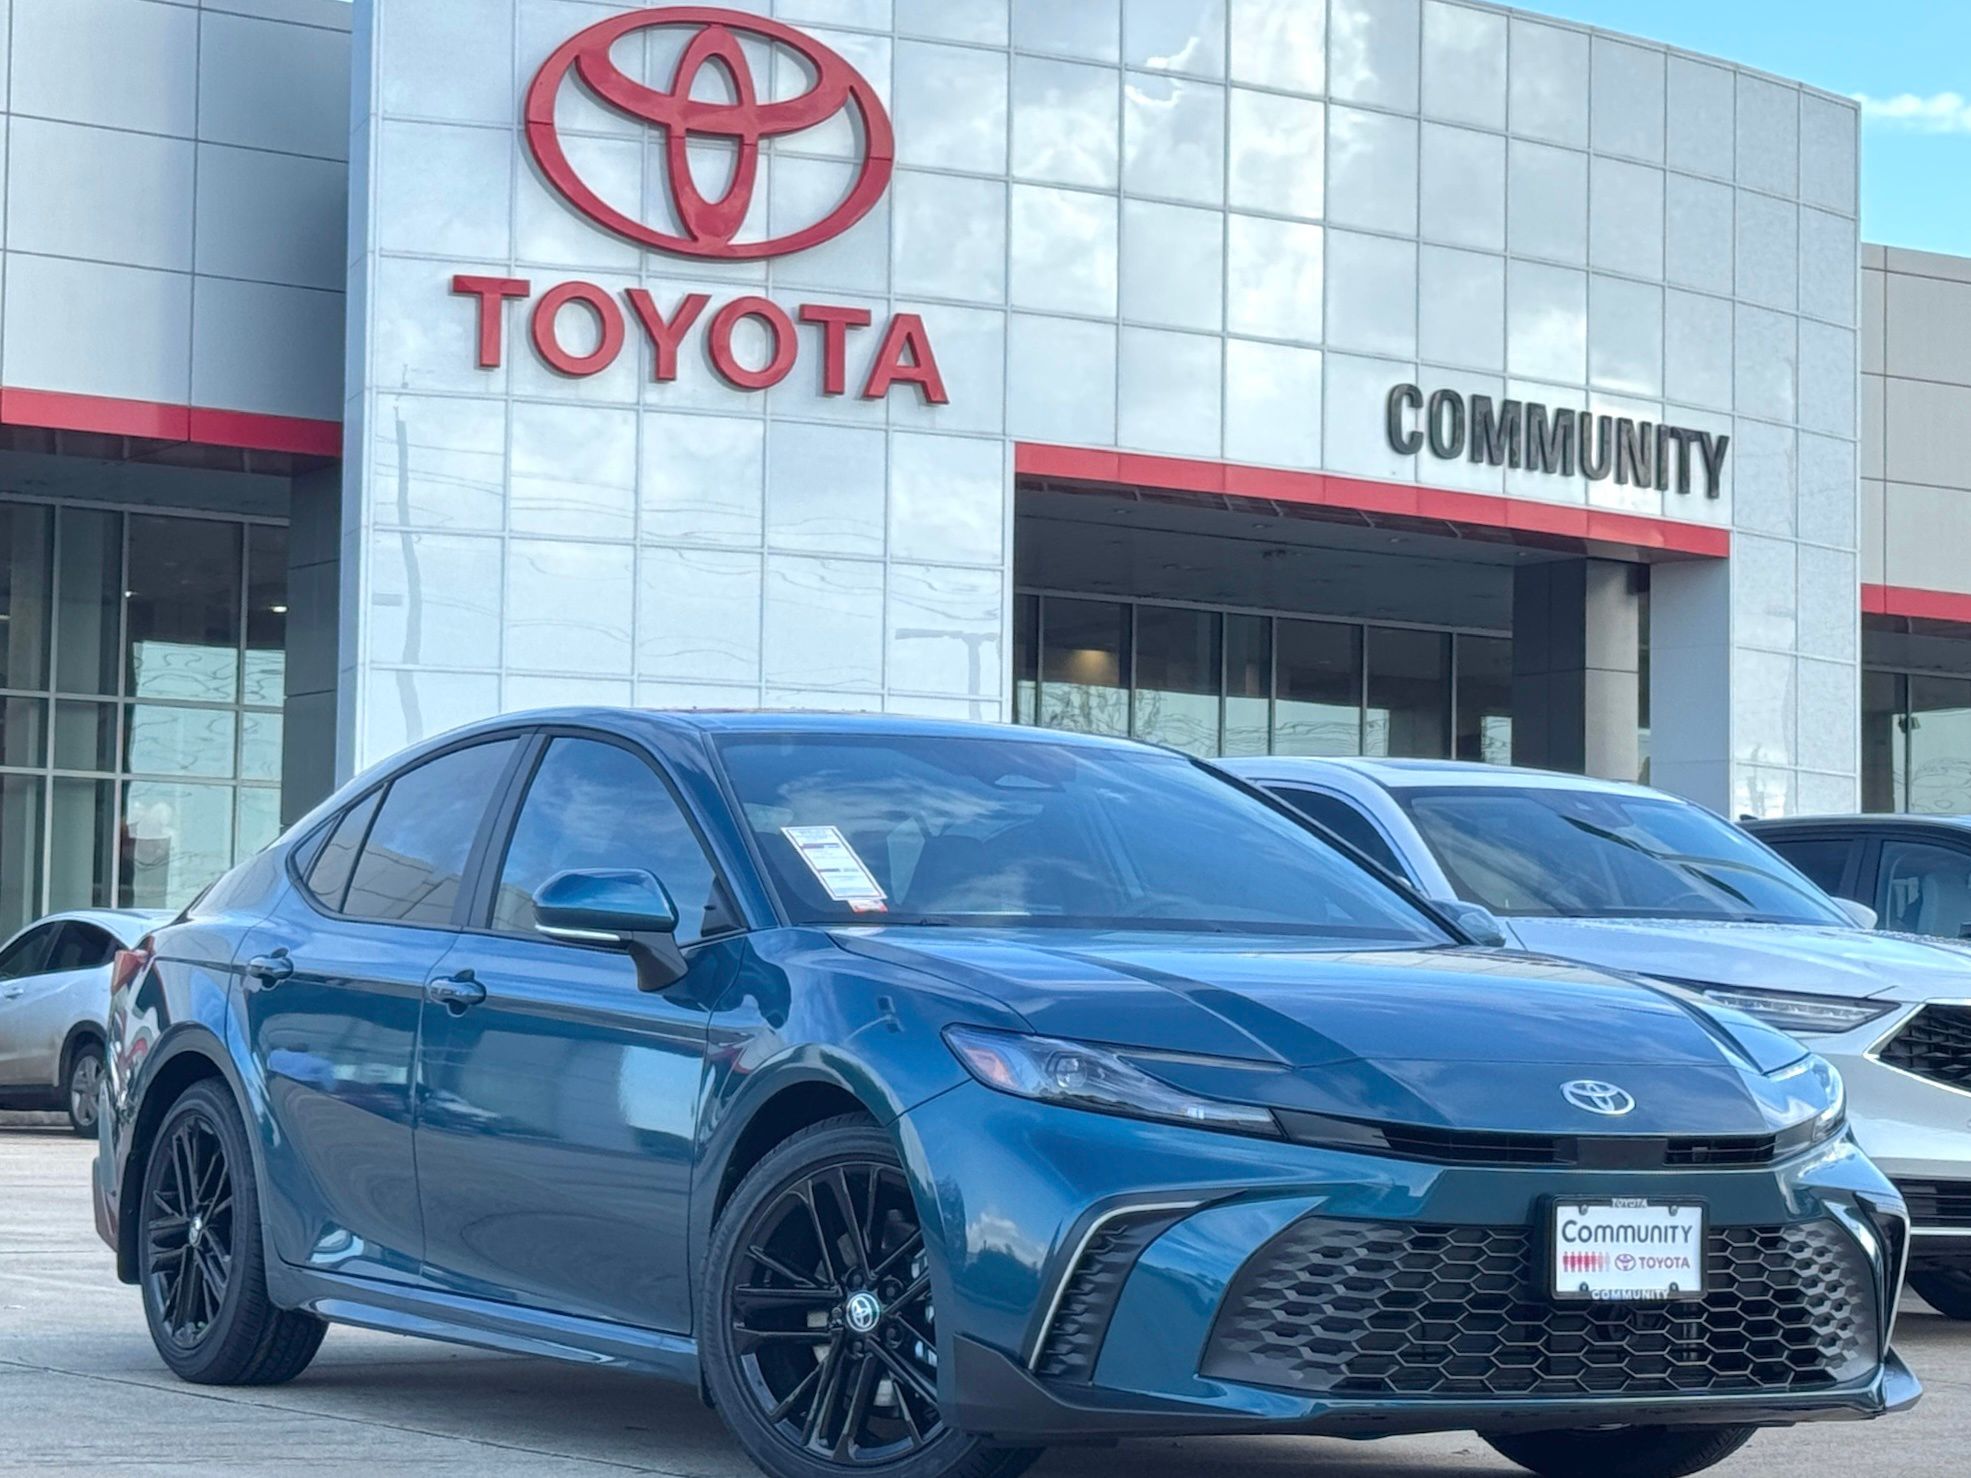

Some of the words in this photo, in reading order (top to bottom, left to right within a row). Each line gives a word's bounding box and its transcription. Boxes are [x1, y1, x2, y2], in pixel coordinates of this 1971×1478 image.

[452, 275, 947, 404] TOYOTA
[1387, 383, 1731, 500] COMMUNITY
[1591, 1289, 1670, 1300] COMMUNITY
[1638, 1257, 1690, 1269] TOYOTA
